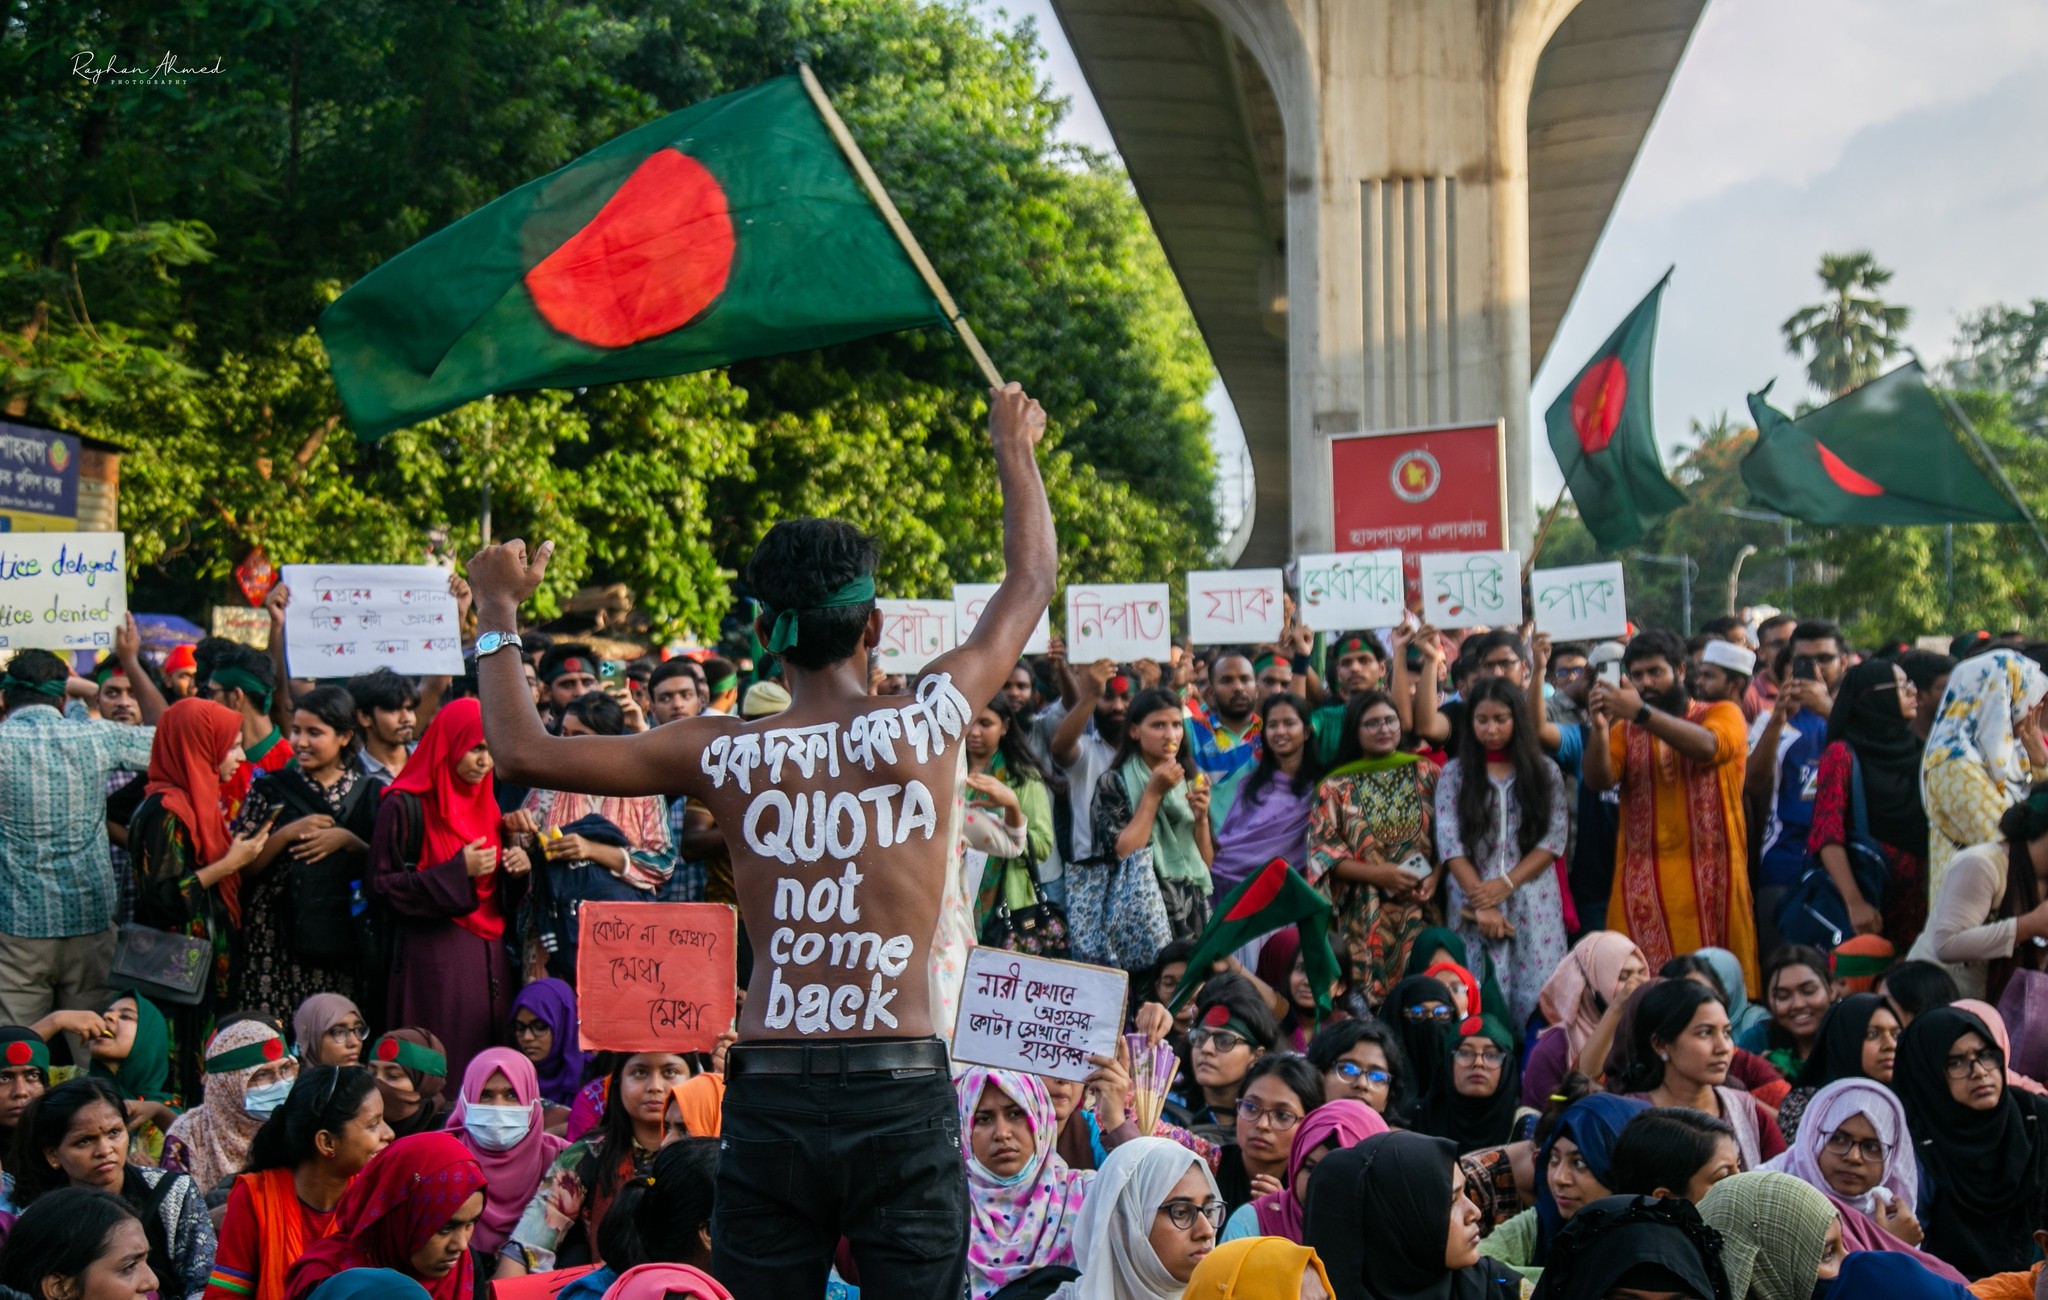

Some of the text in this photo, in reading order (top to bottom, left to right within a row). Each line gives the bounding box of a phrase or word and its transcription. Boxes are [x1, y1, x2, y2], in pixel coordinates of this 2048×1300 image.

[1349, 520, 1488, 546] হাসপাতাল এলাকায়
[0, 542, 119, 587] tice delayed
[1432, 555, 1504, 617] মুক্তি
[0, 593, 114, 627] tice denied
[1070, 592, 1164, 644] নিপাত
[1201, 587, 1274, 624] যাক
[1539, 578, 1617, 621] পাক
[743, 779, 938, 865] QUOTA
[774, 861, 864, 924] not
[592, 915, 718, 962] কোটা না মেধা?
[769, 926, 915, 978] come
[764, 966, 899, 1035] back
[976, 962, 1078, 1006] নারী যেখানে
[647, 998, 712, 1038] মেধা
[969, 1008, 1075, 1046] কোটা সেখানে
